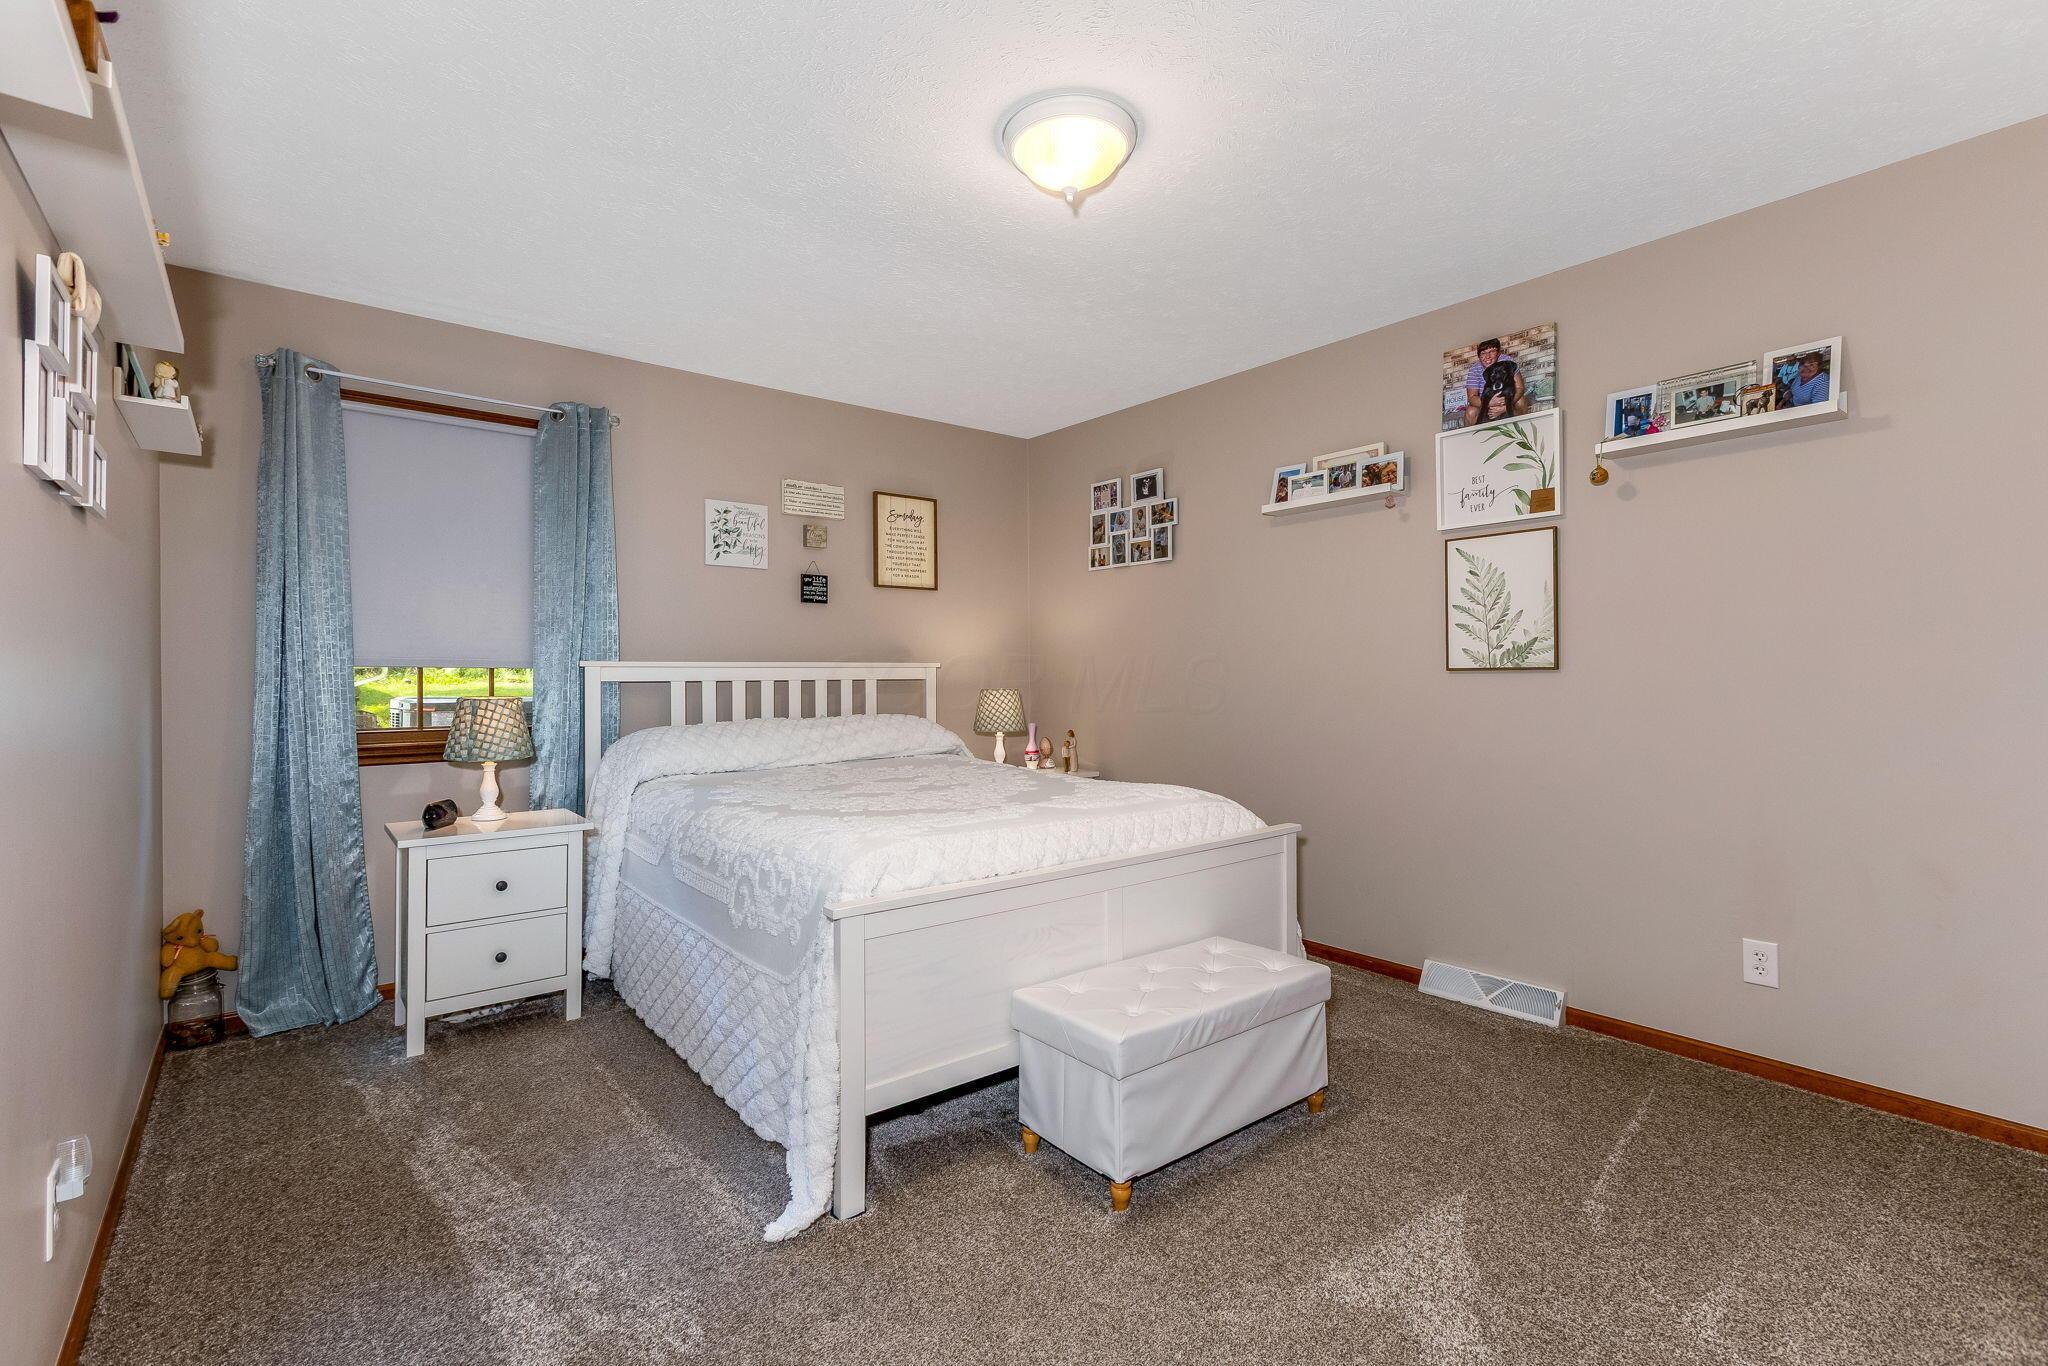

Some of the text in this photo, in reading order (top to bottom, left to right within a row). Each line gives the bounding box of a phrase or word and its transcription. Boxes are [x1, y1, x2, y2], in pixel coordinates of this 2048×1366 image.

[1446, 395, 1466, 404] HOUSE
[1472, 474, 1485, 485] BEST
[1470, 503, 1485, 513] EVER
